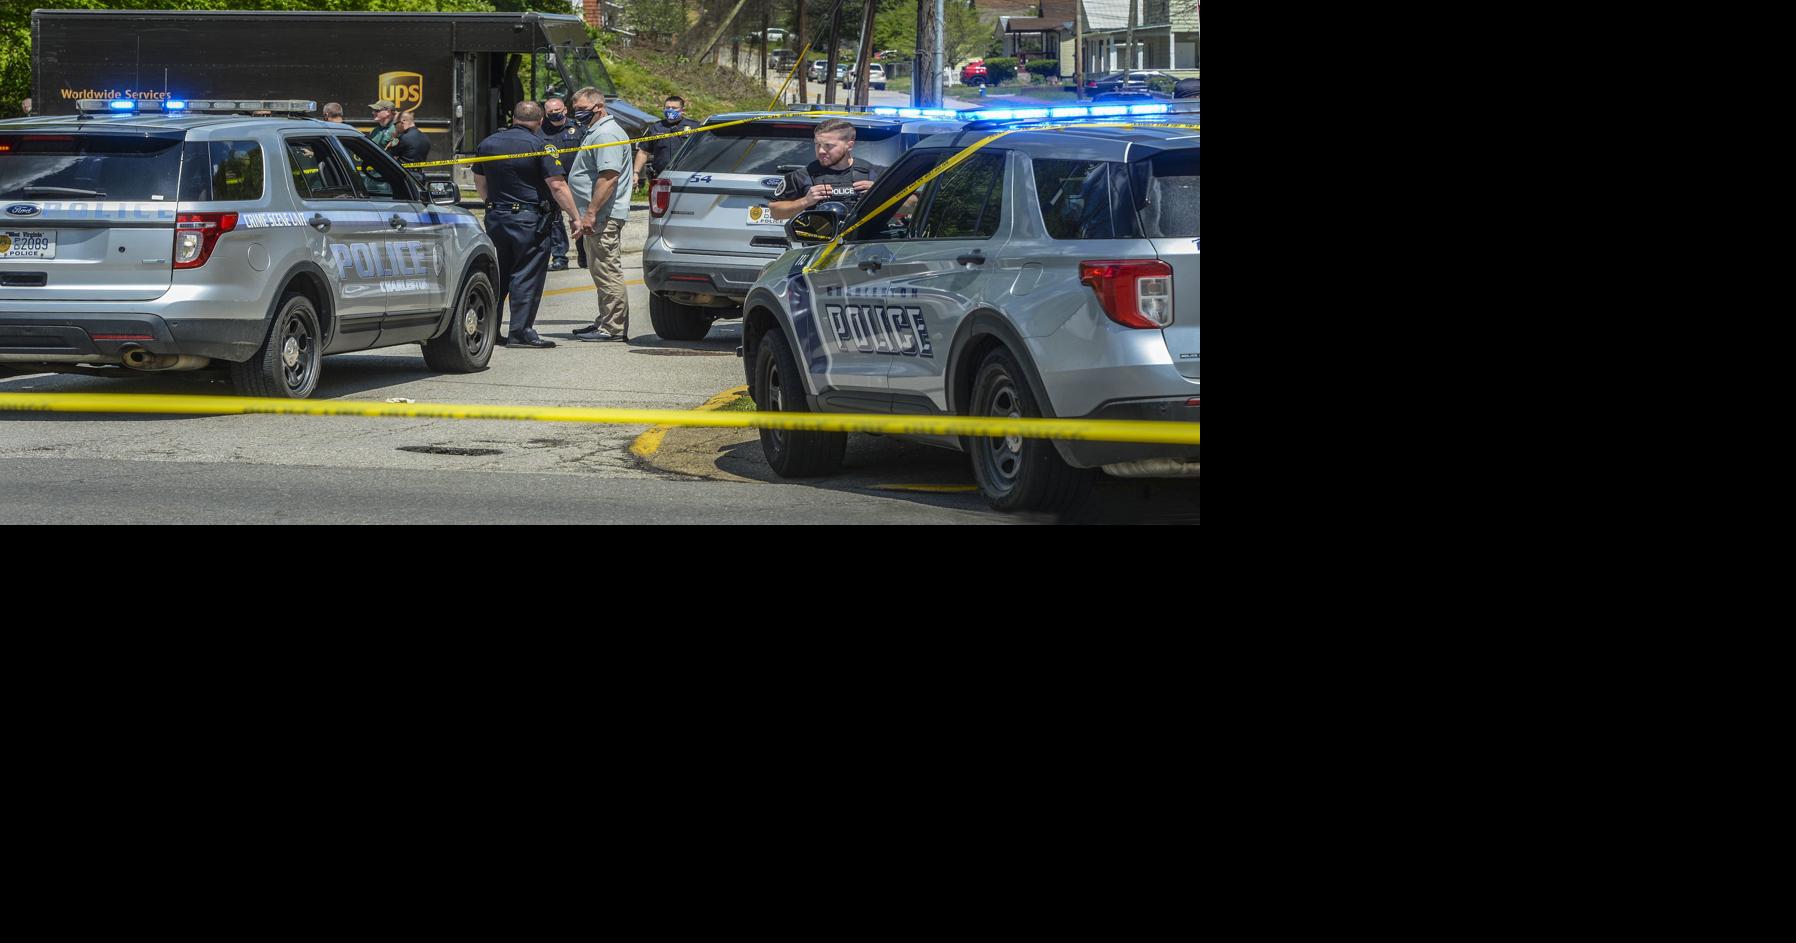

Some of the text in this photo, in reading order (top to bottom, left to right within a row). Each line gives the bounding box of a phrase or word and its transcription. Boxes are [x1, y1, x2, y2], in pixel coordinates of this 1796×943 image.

[61, 89, 171, 99] Worldwide Services
[382, 84, 420, 108] ups
[690, 174, 712, 184] 54
[831, 187, 854, 195] OLICE
[11, 206, 32, 214] Ford
[42, 202, 174, 219] POLICE
[329, 241, 428, 279] POLICE
[825, 303, 934, 359] POLICE
